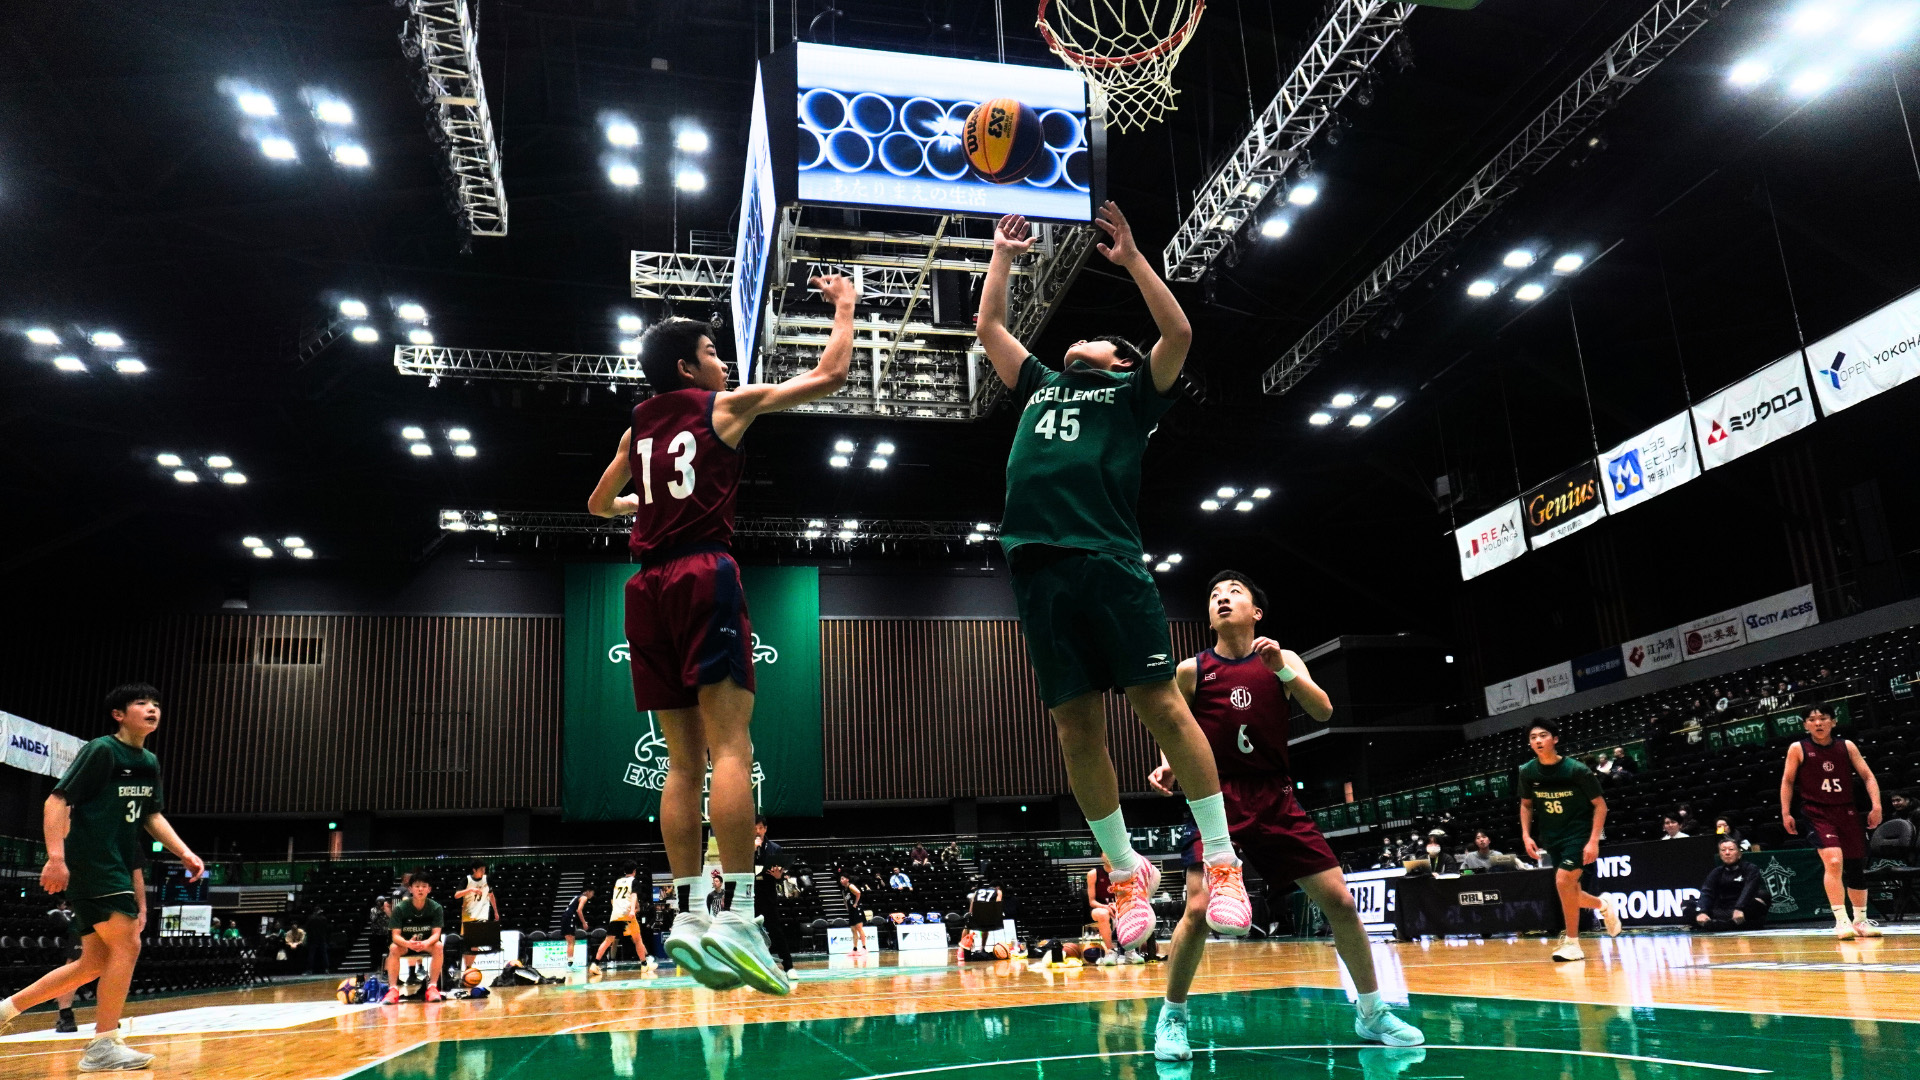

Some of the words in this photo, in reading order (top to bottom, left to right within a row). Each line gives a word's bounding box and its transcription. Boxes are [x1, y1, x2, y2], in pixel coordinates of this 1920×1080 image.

[1839, 359, 1871, 382] OPEN
[1729, 387, 1803, 432] ミツウロコ
[1034, 407, 1081, 442] 45
[1642, 437, 1665, 454] トヨタ
[1645, 442, 1687, 470] モビリティ
[636, 430, 697, 505] 13
[1647, 463, 1676, 483] 神奈川
[1529, 479, 1595, 526] Genius
[11, 735, 49, 757] ANDEX
[1237, 724, 1254, 753] 6
[1821, 779, 1842, 792] 45
[1544, 800, 1563, 814] 36
[262, 864, 290, 875] REAL
[1596, 855, 1632, 878] NTS
[616, 885, 629, 899] 72
[976, 889, 996, 902] 27
[1461, 893, 1483, 903] RBL
